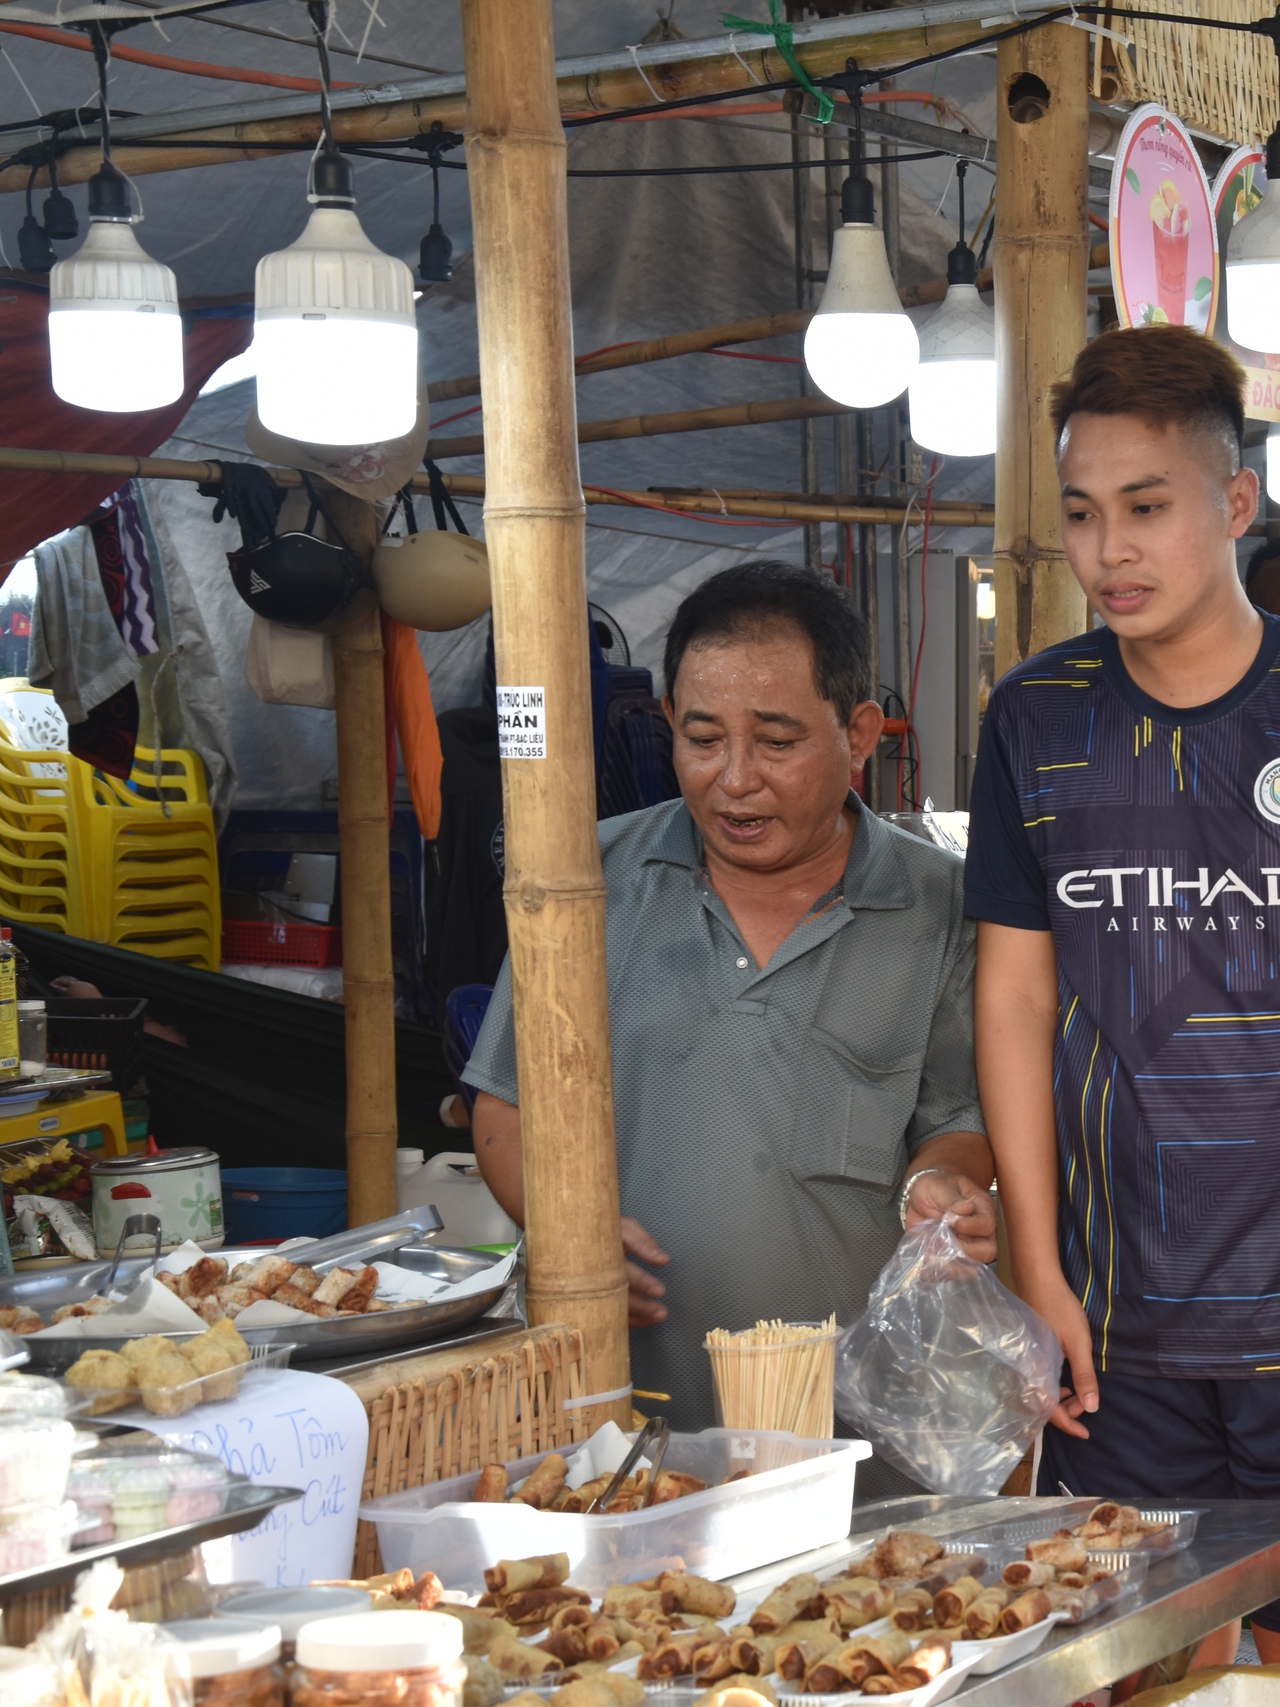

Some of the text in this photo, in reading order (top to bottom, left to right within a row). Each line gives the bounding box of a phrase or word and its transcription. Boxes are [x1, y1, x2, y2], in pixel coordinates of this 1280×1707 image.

[522, 692, 543, 708] LINH
[1106, 915, 1266, 932] AIRWAYS
[273, 1408, 350, 1469] Tôm
